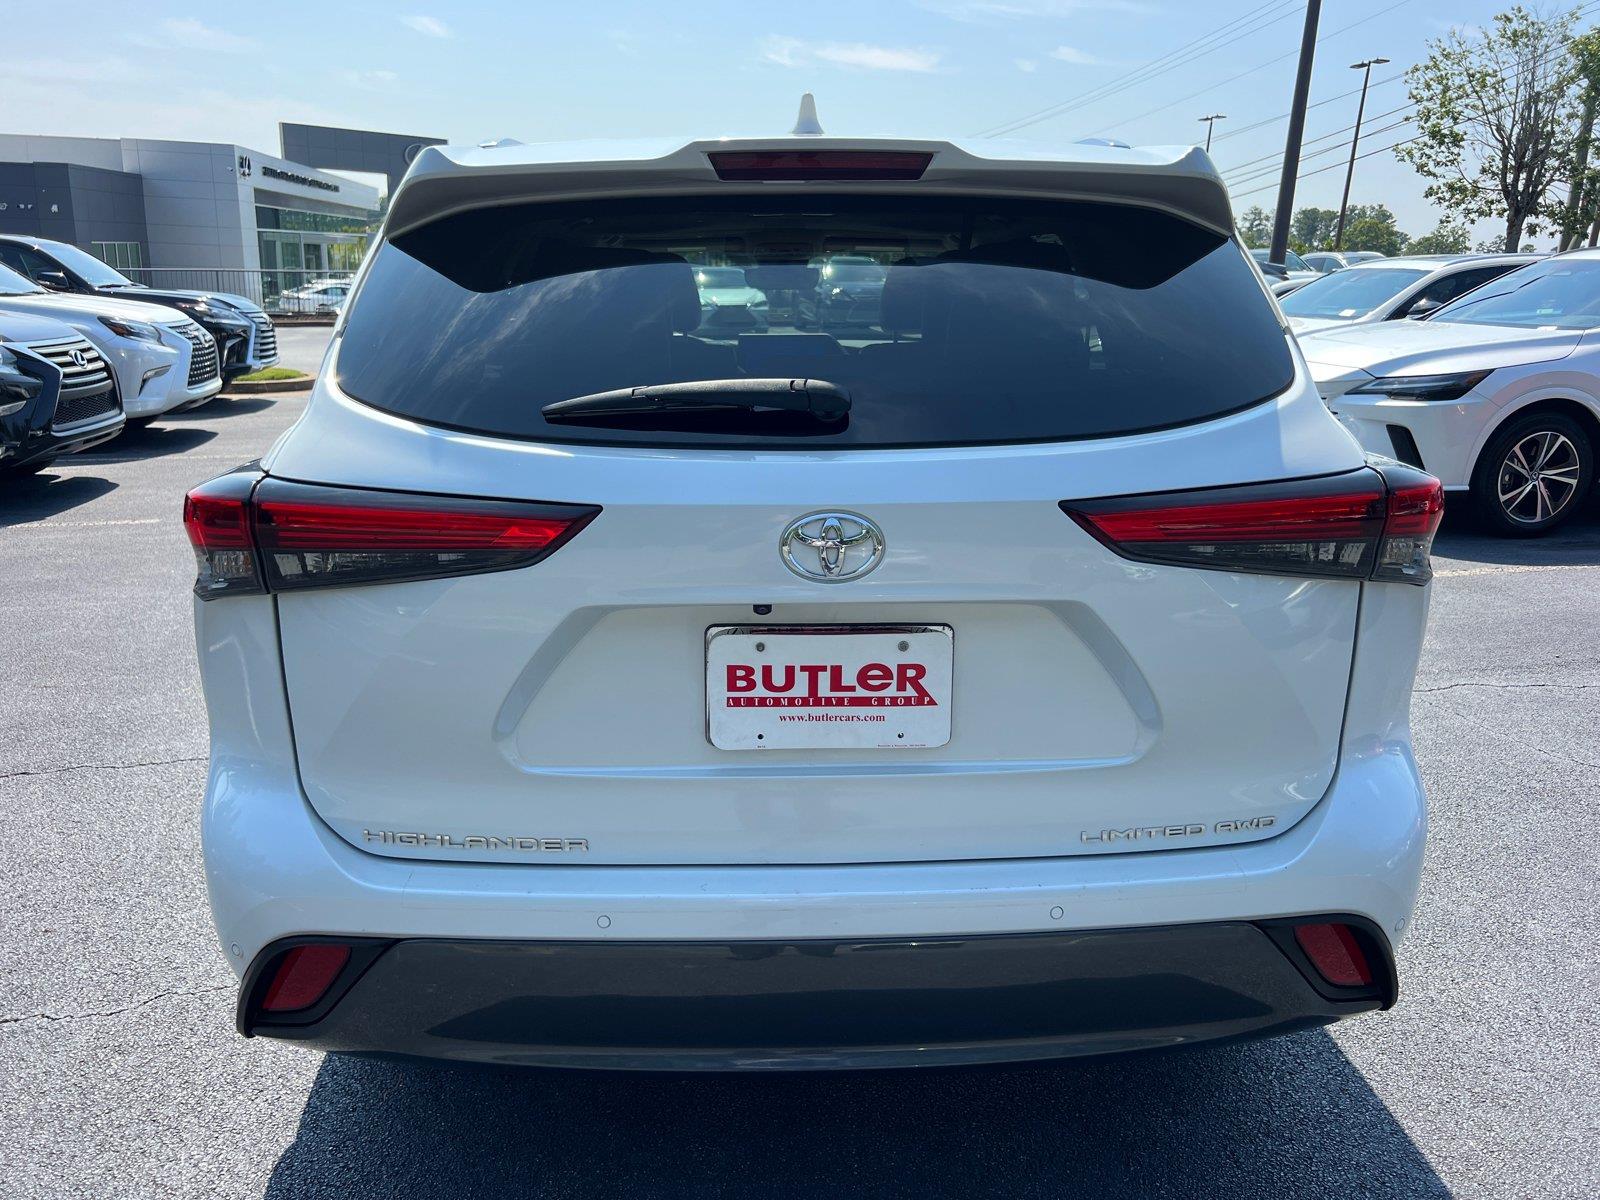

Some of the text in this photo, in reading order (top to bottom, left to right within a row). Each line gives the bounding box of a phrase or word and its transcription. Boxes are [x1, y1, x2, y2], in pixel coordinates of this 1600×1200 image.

[728, 696, 932, 706] AUTOMOTIVE GROUP
[779, 713, 886, 723] www.butlercars.com
[1081, 816, 1275, 844] LIMITED AWD
[363, 829, 589, 852] HIGHLANDER
